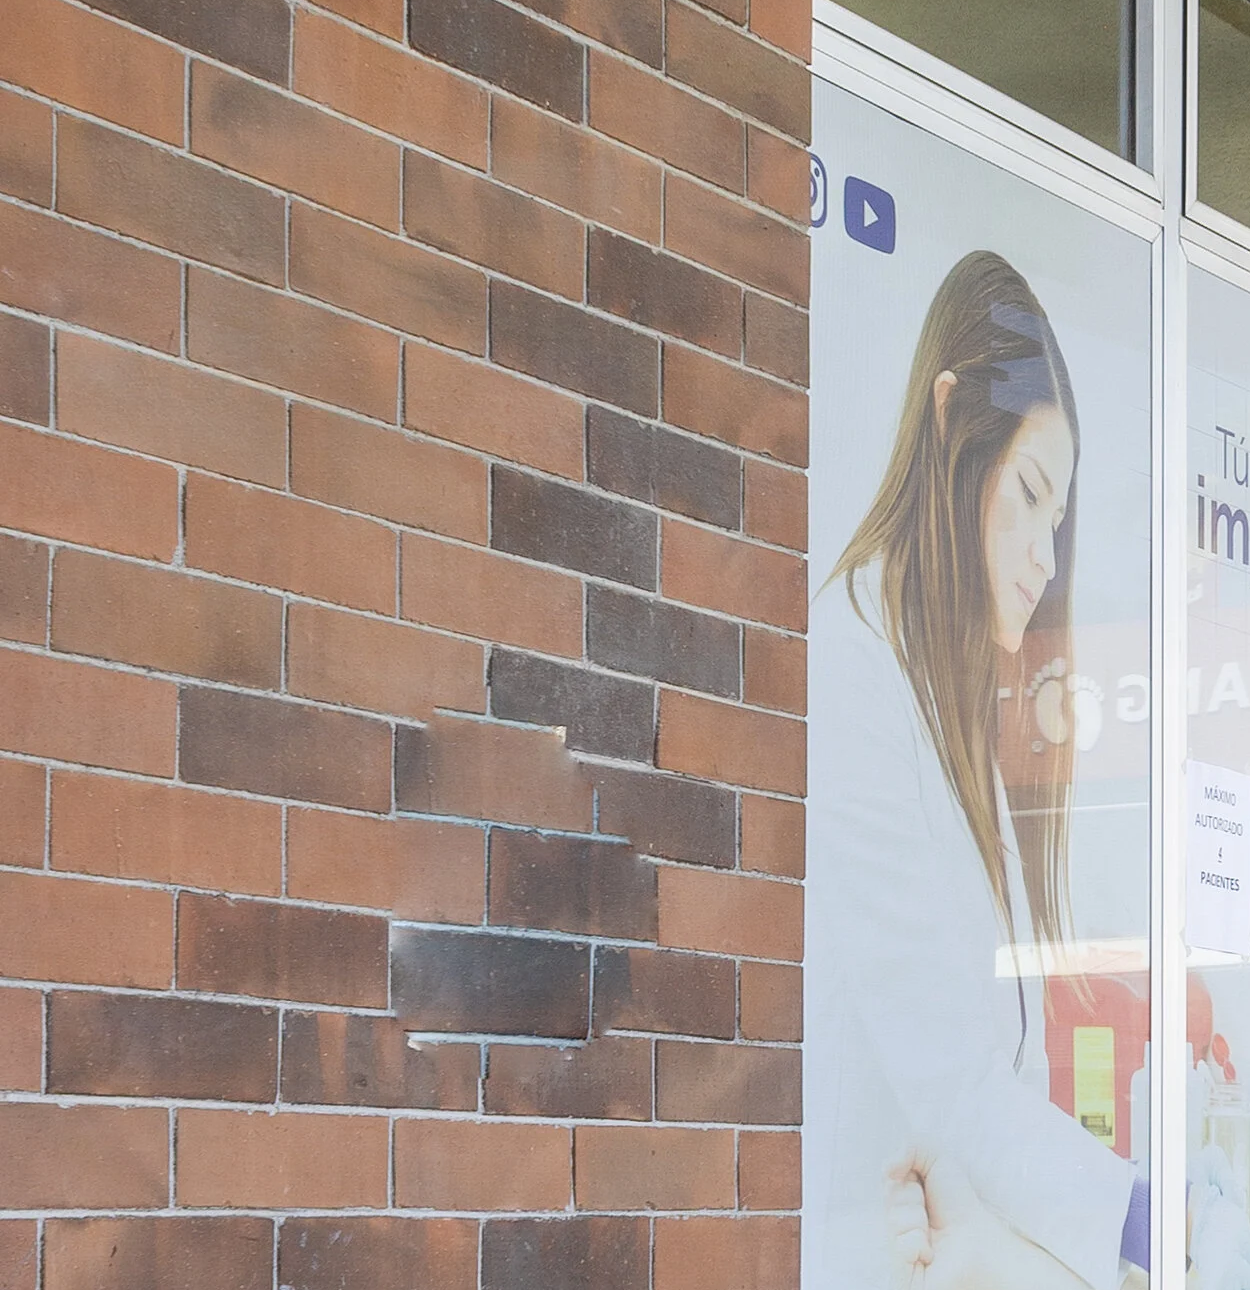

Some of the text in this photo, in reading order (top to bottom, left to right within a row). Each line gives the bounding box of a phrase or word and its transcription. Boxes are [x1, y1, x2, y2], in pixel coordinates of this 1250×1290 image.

[1216, 425, 1250, 488] Tú
[1204, 785, 1237, 807] MÁXIMO
[1195, 813, 1244, 837] AUTORIZADO
